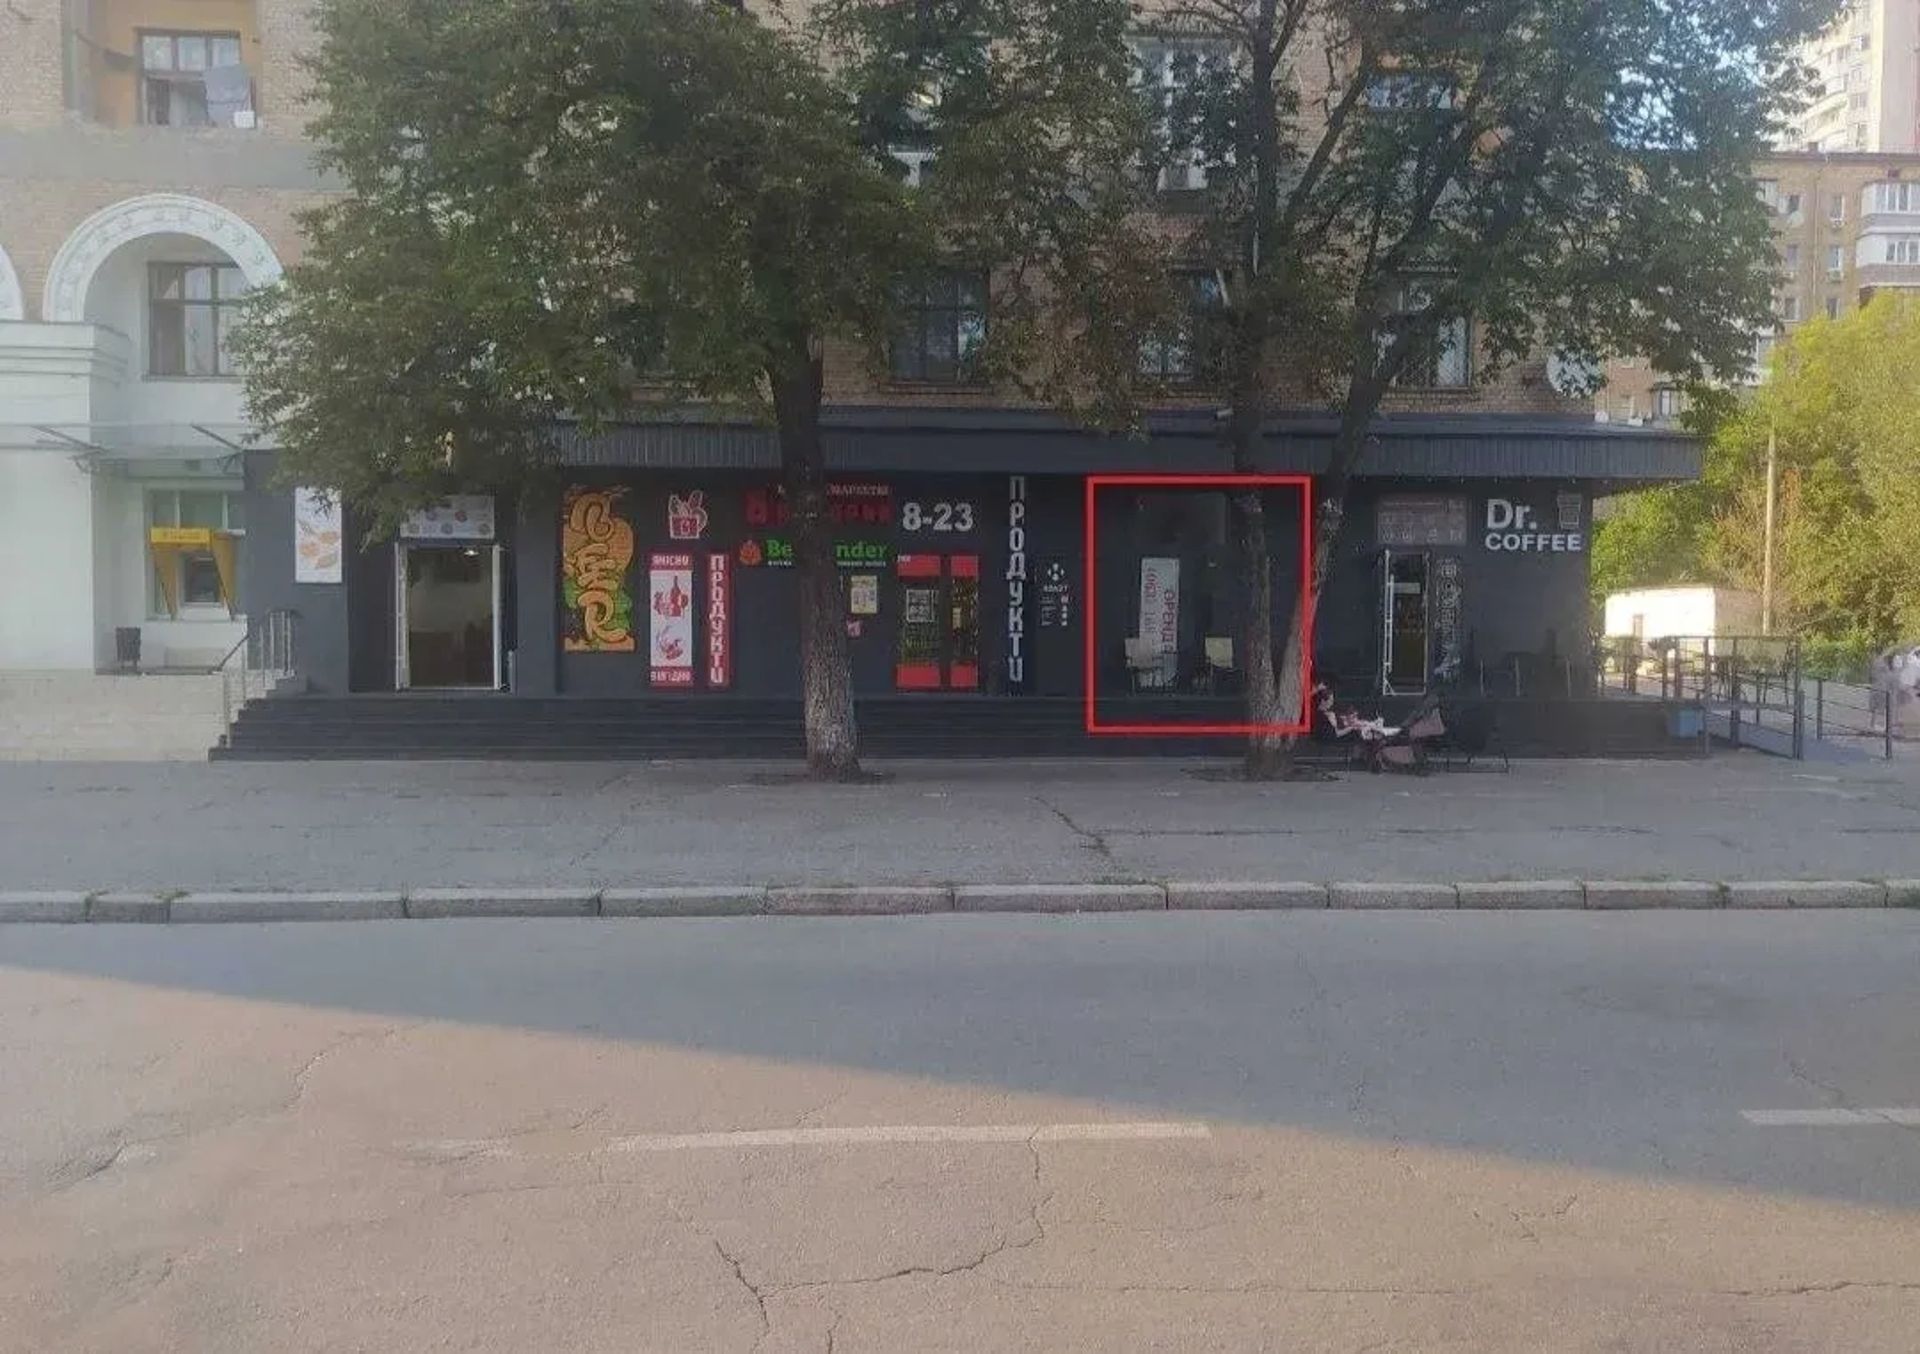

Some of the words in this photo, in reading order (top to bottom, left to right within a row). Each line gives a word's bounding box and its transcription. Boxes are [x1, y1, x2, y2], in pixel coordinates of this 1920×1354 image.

[902, 502, 974, 531] 8-23
[1487, 499, 1538, 530] Dr.
[1485, 533, 1582, 551] COFFEE
[1006, 476, 1026, 682] ПРОДУКТИ
[709, 554, 725, 684] ПРОДУКТИ
